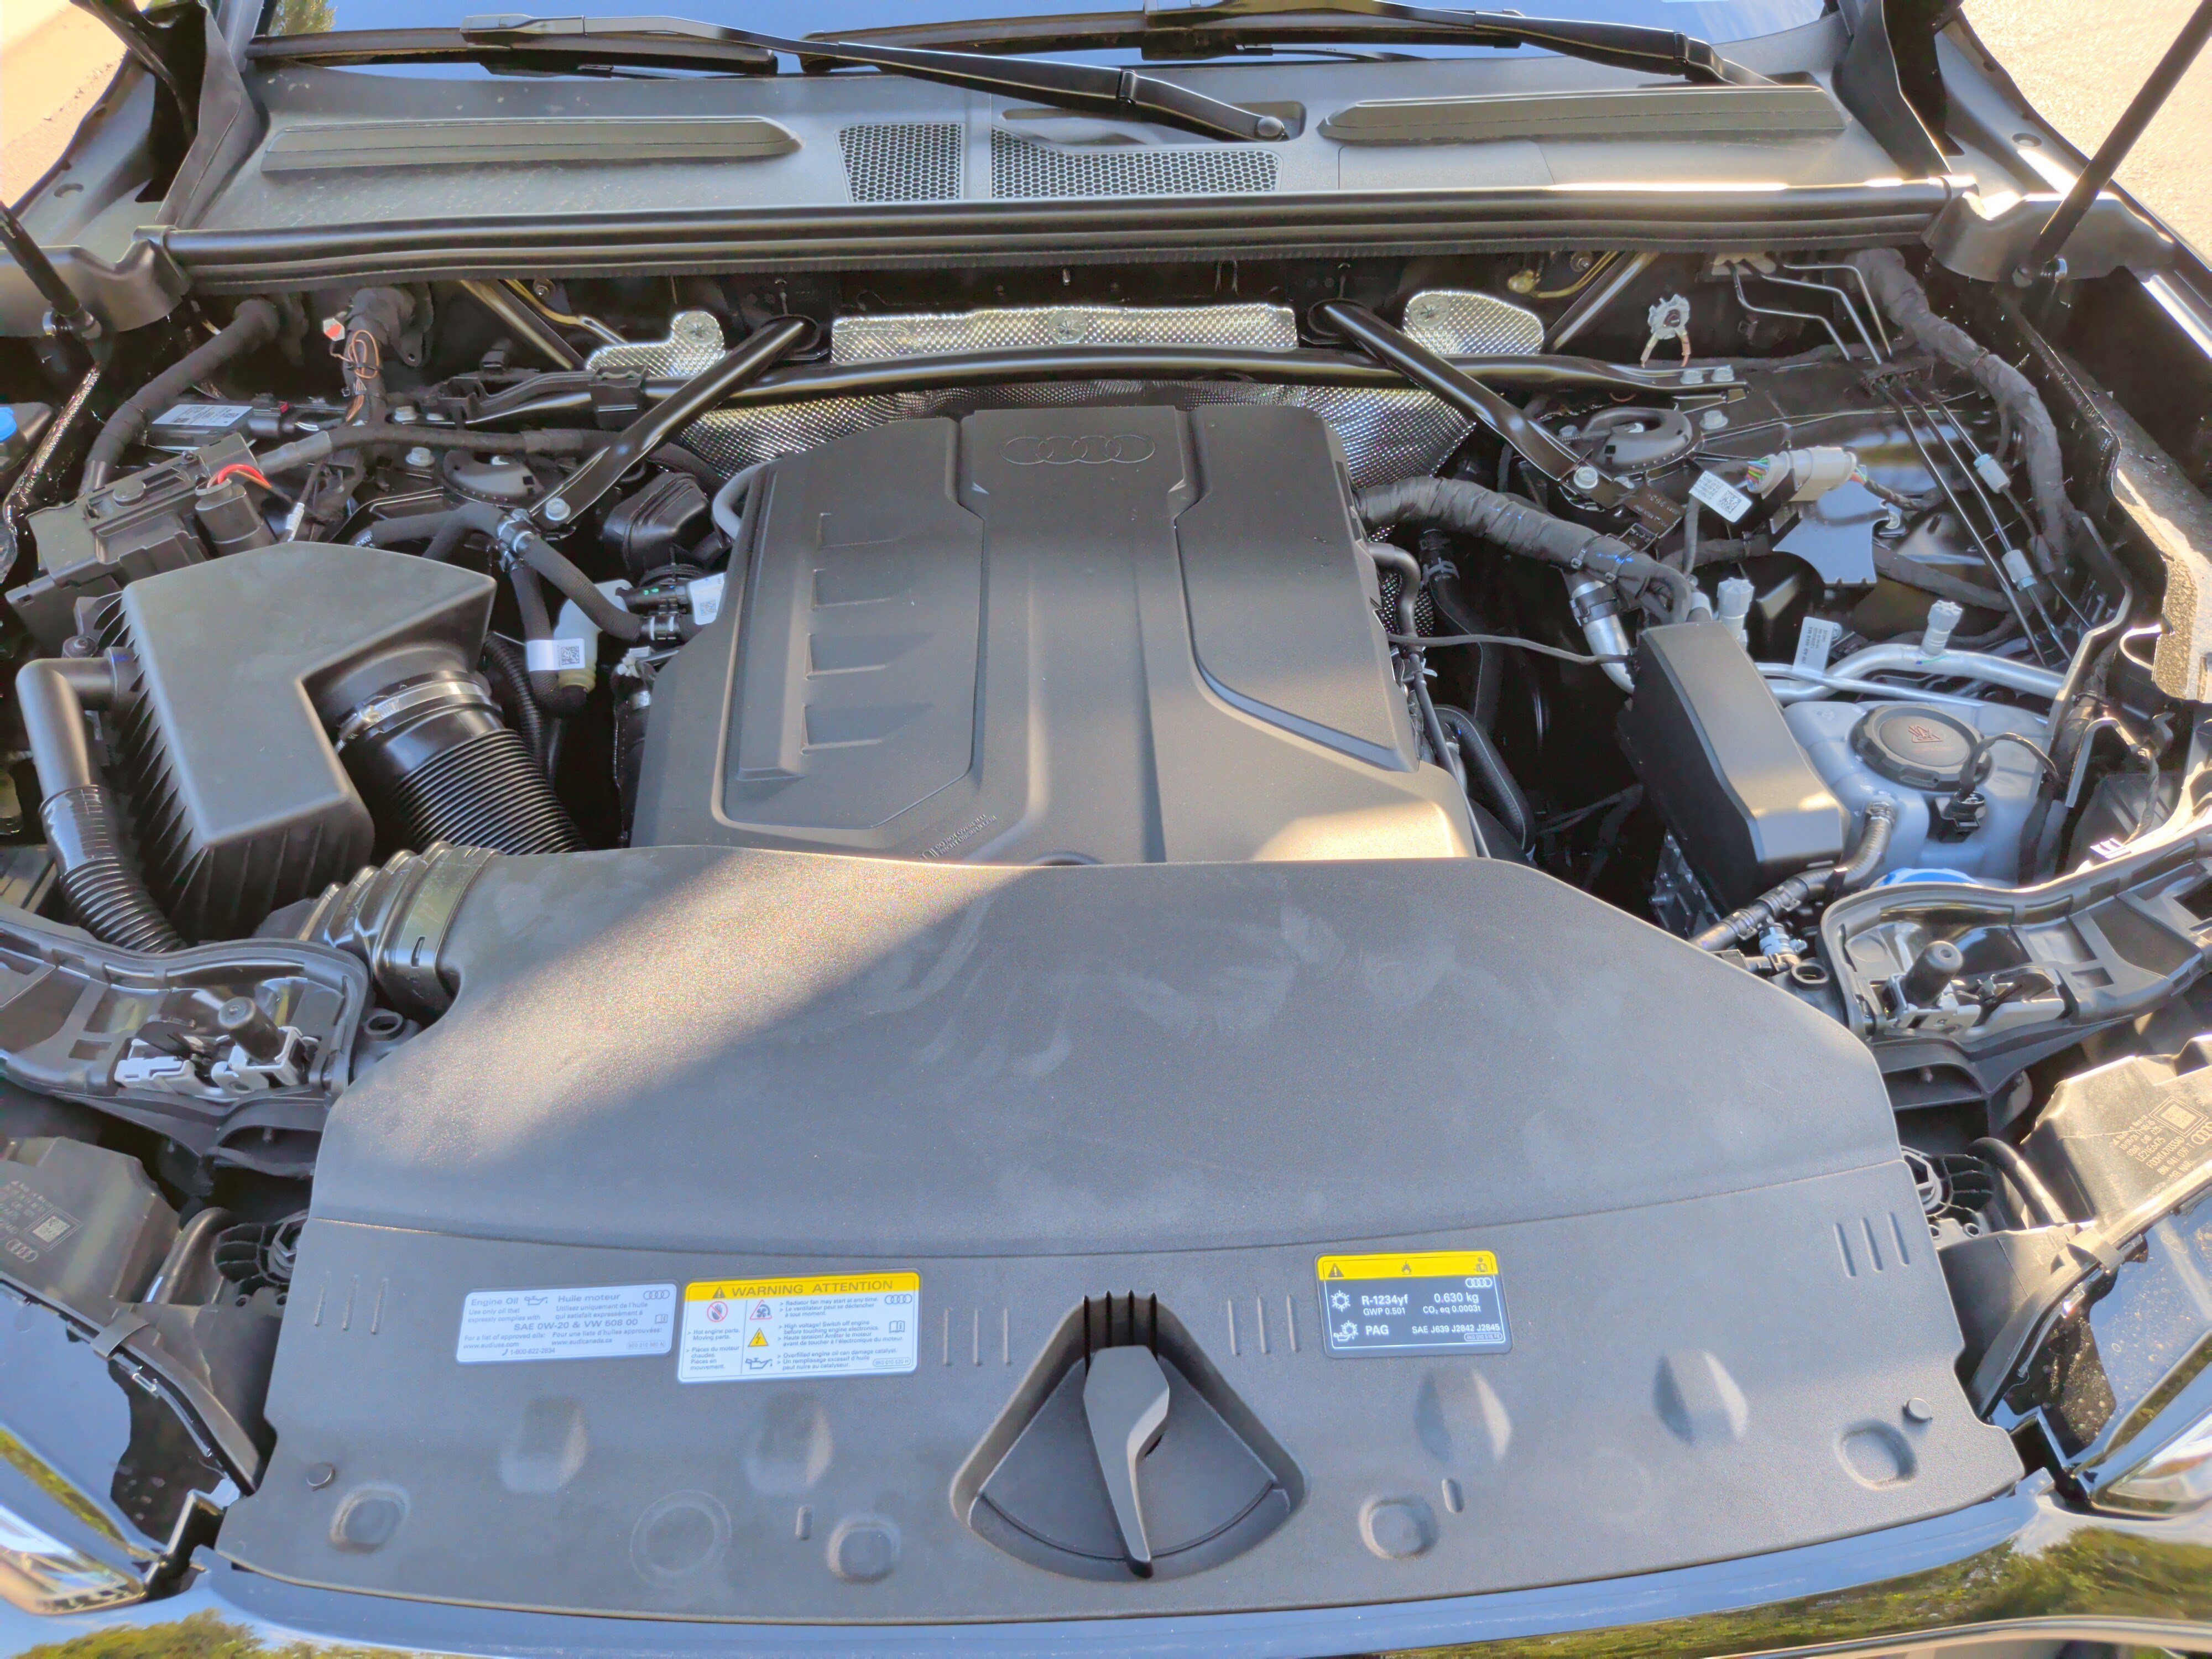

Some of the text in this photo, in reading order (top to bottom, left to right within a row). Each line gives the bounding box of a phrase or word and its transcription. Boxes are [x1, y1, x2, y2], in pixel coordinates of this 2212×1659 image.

[732, 1281, 893, 1297] WARNING ATTENTION
[1362, 1295, 1408, 1306] R-1234yf
[1434, 1292, 1479, 1303] 0.630 kg
[1363, 1307, 1405, 1316] GWP 0.501
[1440, 1307, 1450, 1315] eq
[538, 1322, 569, 1330] 0W-20
[1365, 1325, 1389, 1335] PAG
